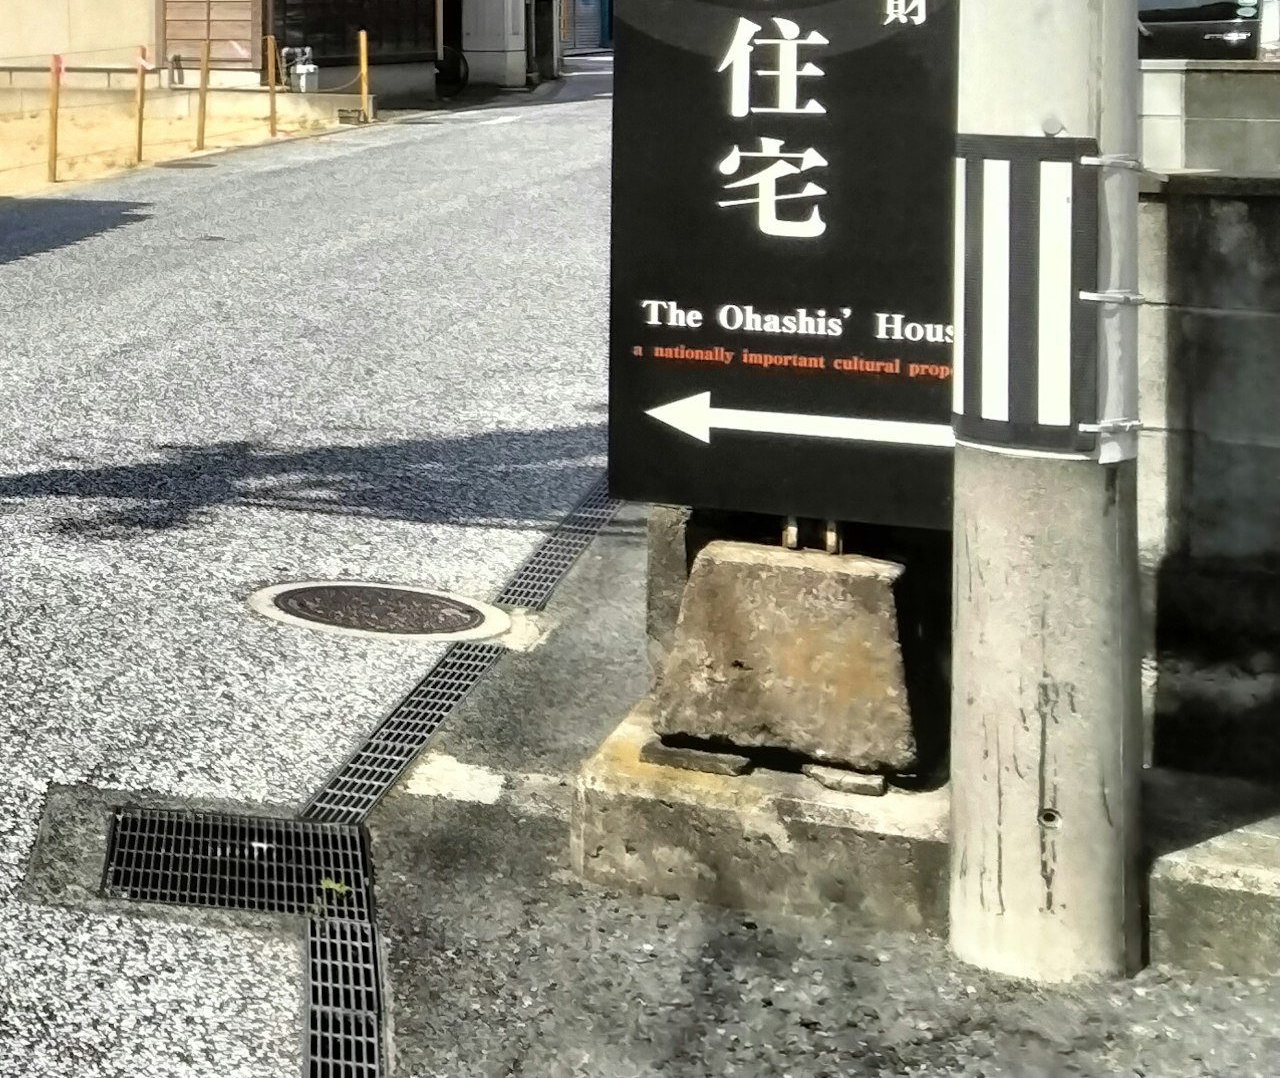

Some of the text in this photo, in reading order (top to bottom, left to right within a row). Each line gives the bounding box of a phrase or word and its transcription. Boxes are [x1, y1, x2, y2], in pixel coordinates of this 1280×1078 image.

[642, 300, 703, 328] The
[633, 345, 953, 379] a nationally important cultural prop
